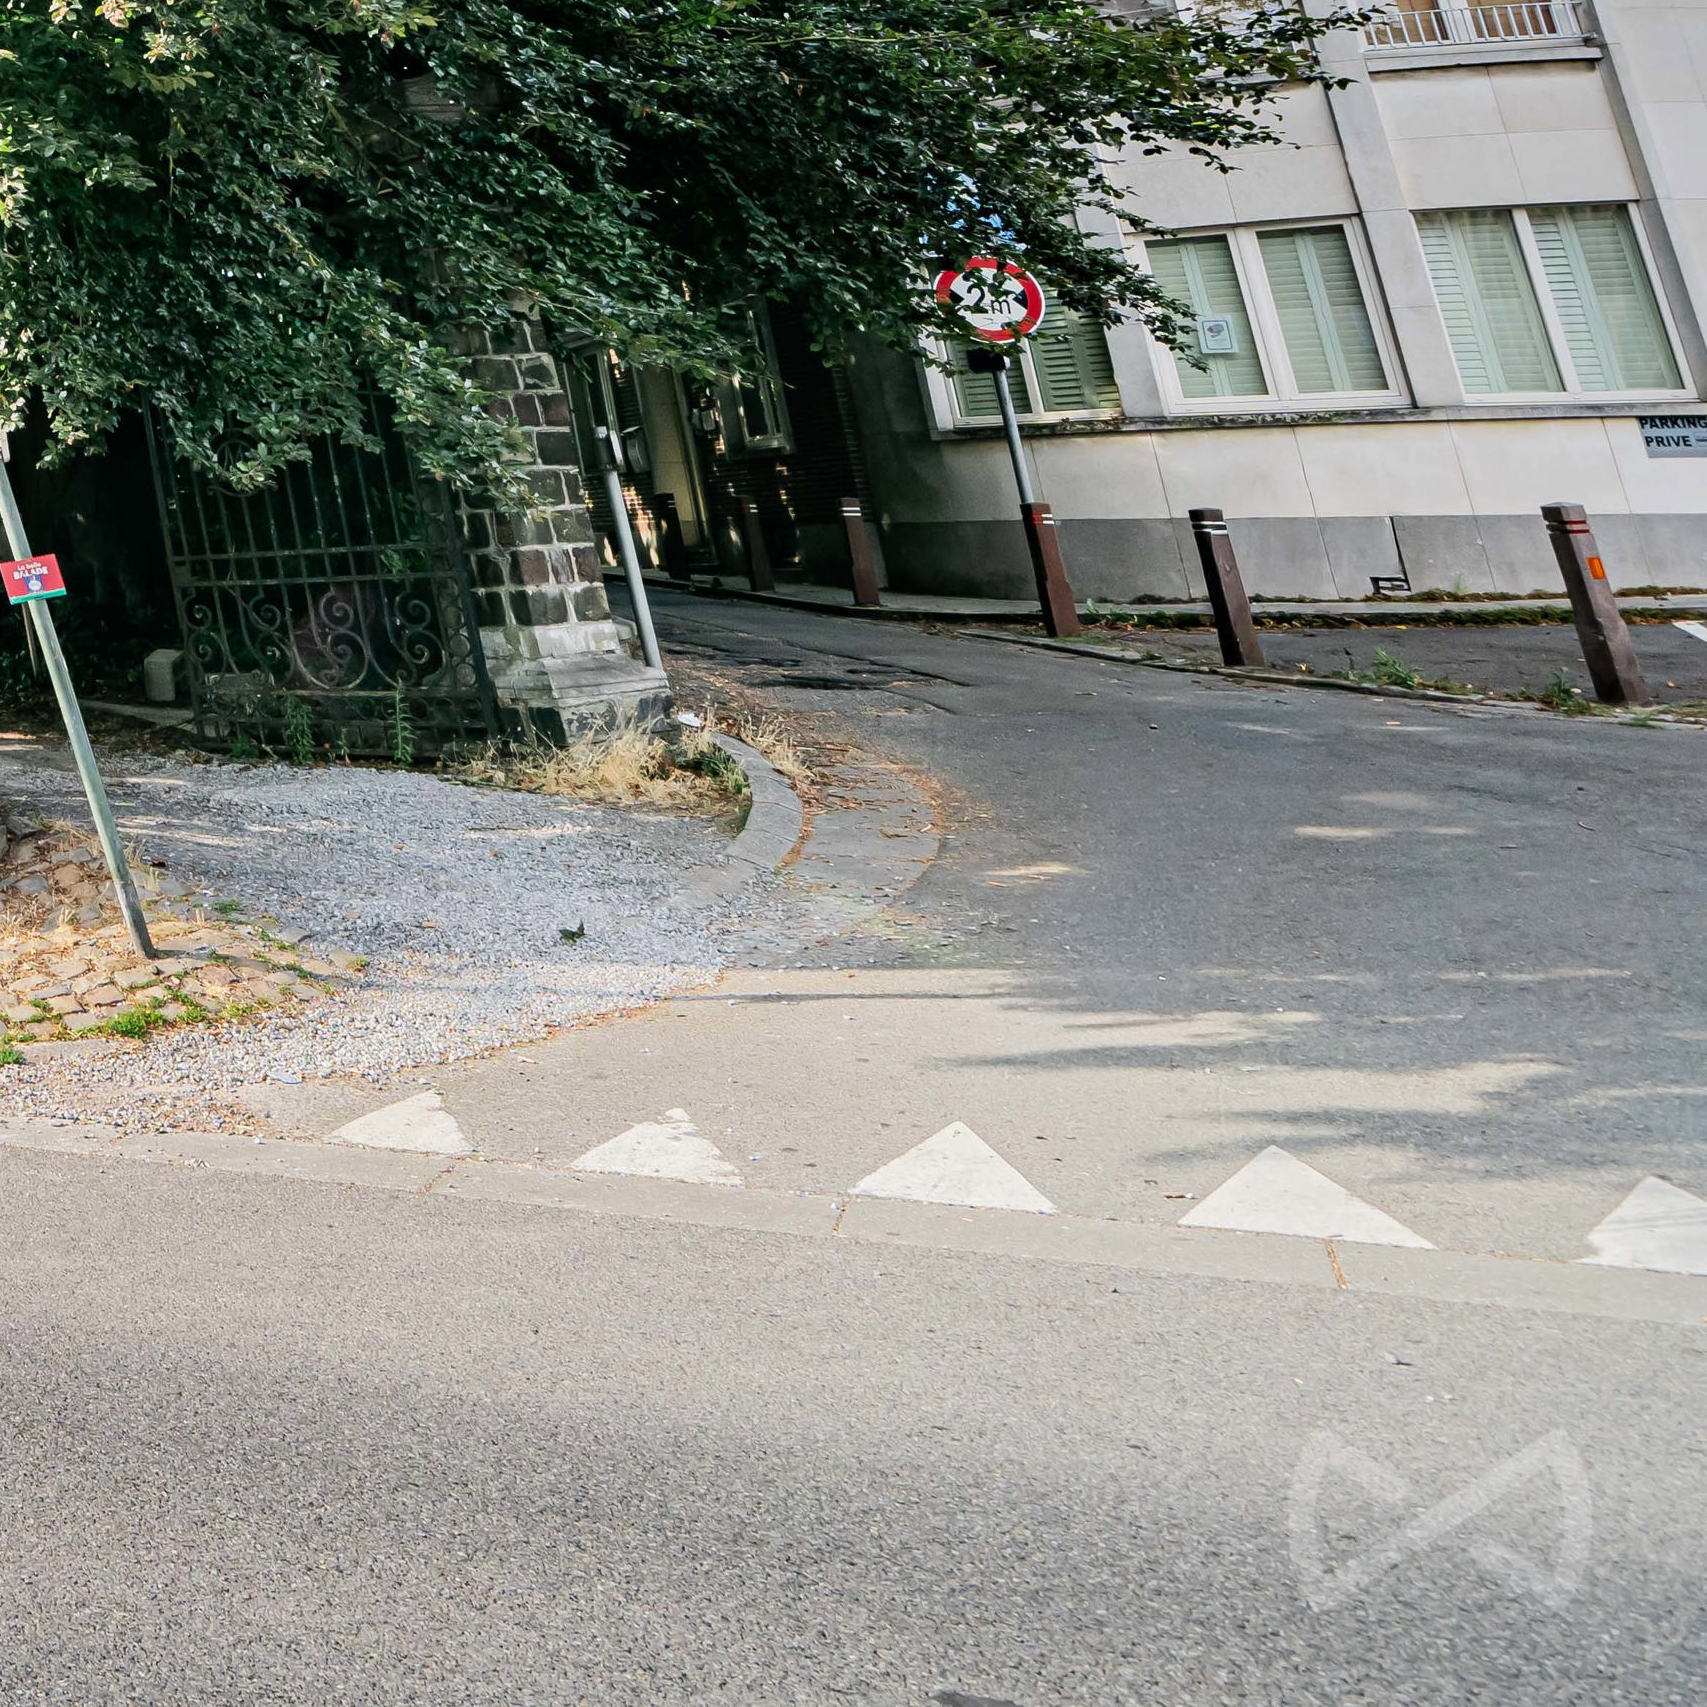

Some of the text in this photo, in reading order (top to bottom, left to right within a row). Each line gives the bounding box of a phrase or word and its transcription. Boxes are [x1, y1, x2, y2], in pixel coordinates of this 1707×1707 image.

[1639, 416, 1707, 430] PARKING
[1644, 435, 1693, 448] PRIVE
[25, 561, 42, 570] belle
[12, 565, 49, 581] BALADE
